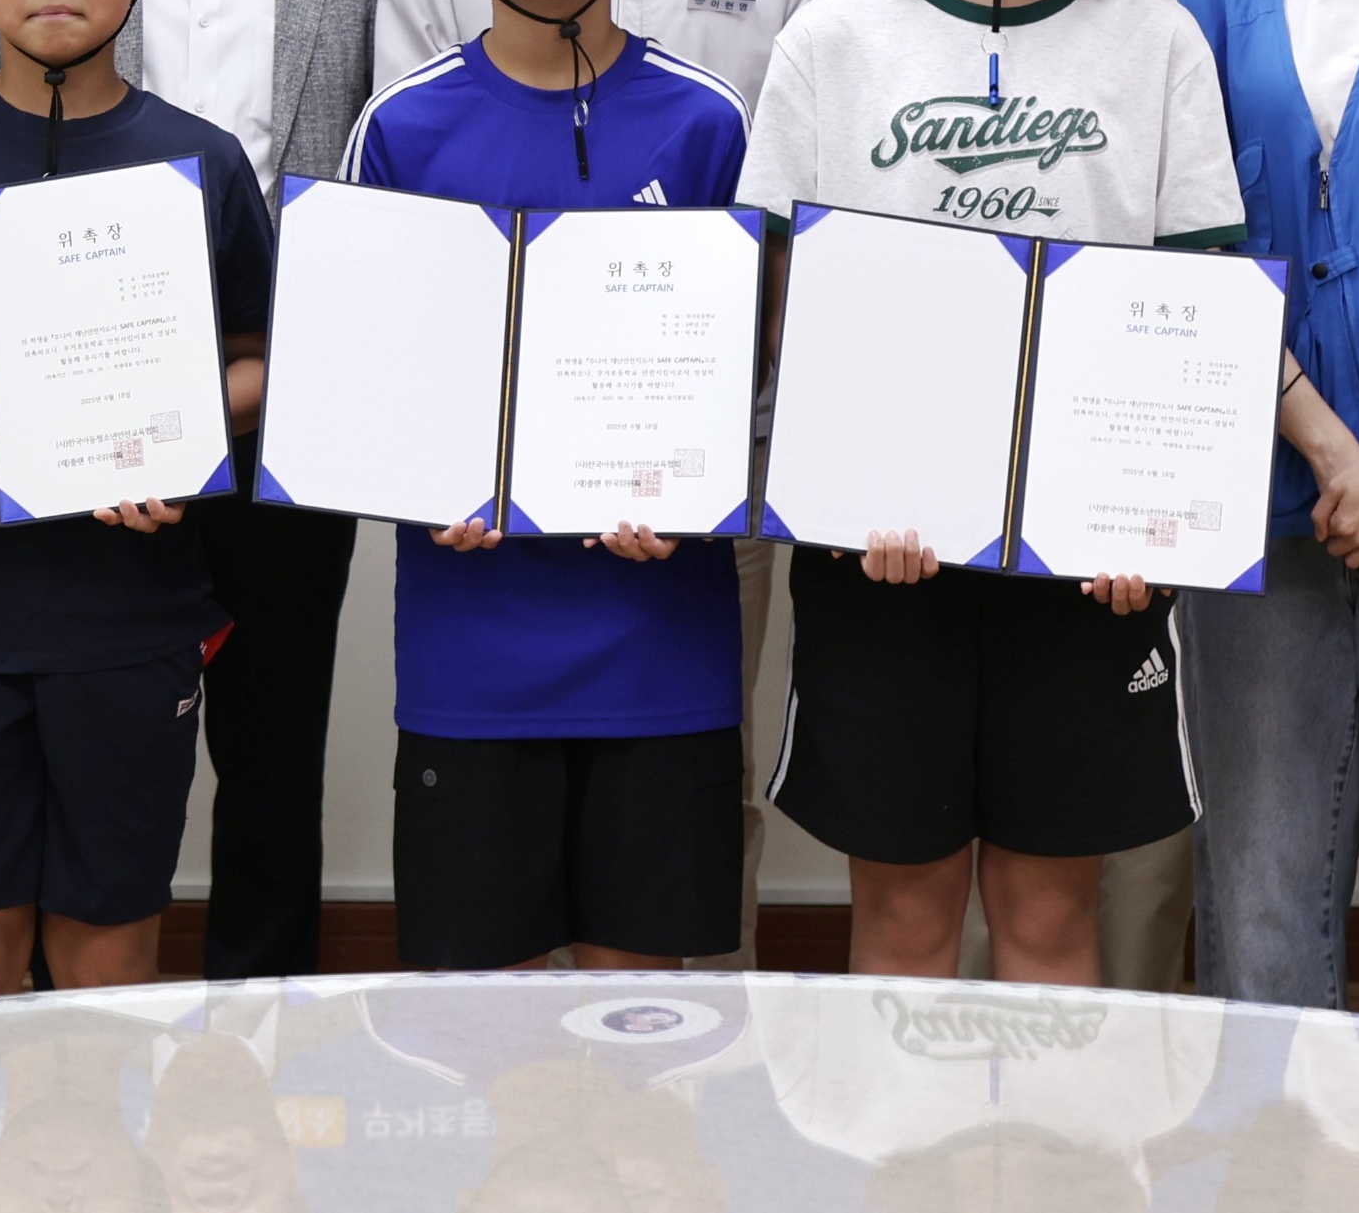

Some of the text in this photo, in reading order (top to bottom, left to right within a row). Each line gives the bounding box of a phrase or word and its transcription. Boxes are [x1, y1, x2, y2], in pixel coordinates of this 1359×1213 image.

[870, 95, 1108, 174] Sandiego
[933, 185, 1060, 221] 1960 SINCE
[58, 246, 126, 265] SAFE CAPTAIN
[605, 283, 674, 293] SAFE CAPTAIN
[1126, 324, 1197, 338] SAFE CAPTAIN
[1127, 668, 1169, 693] adidas
